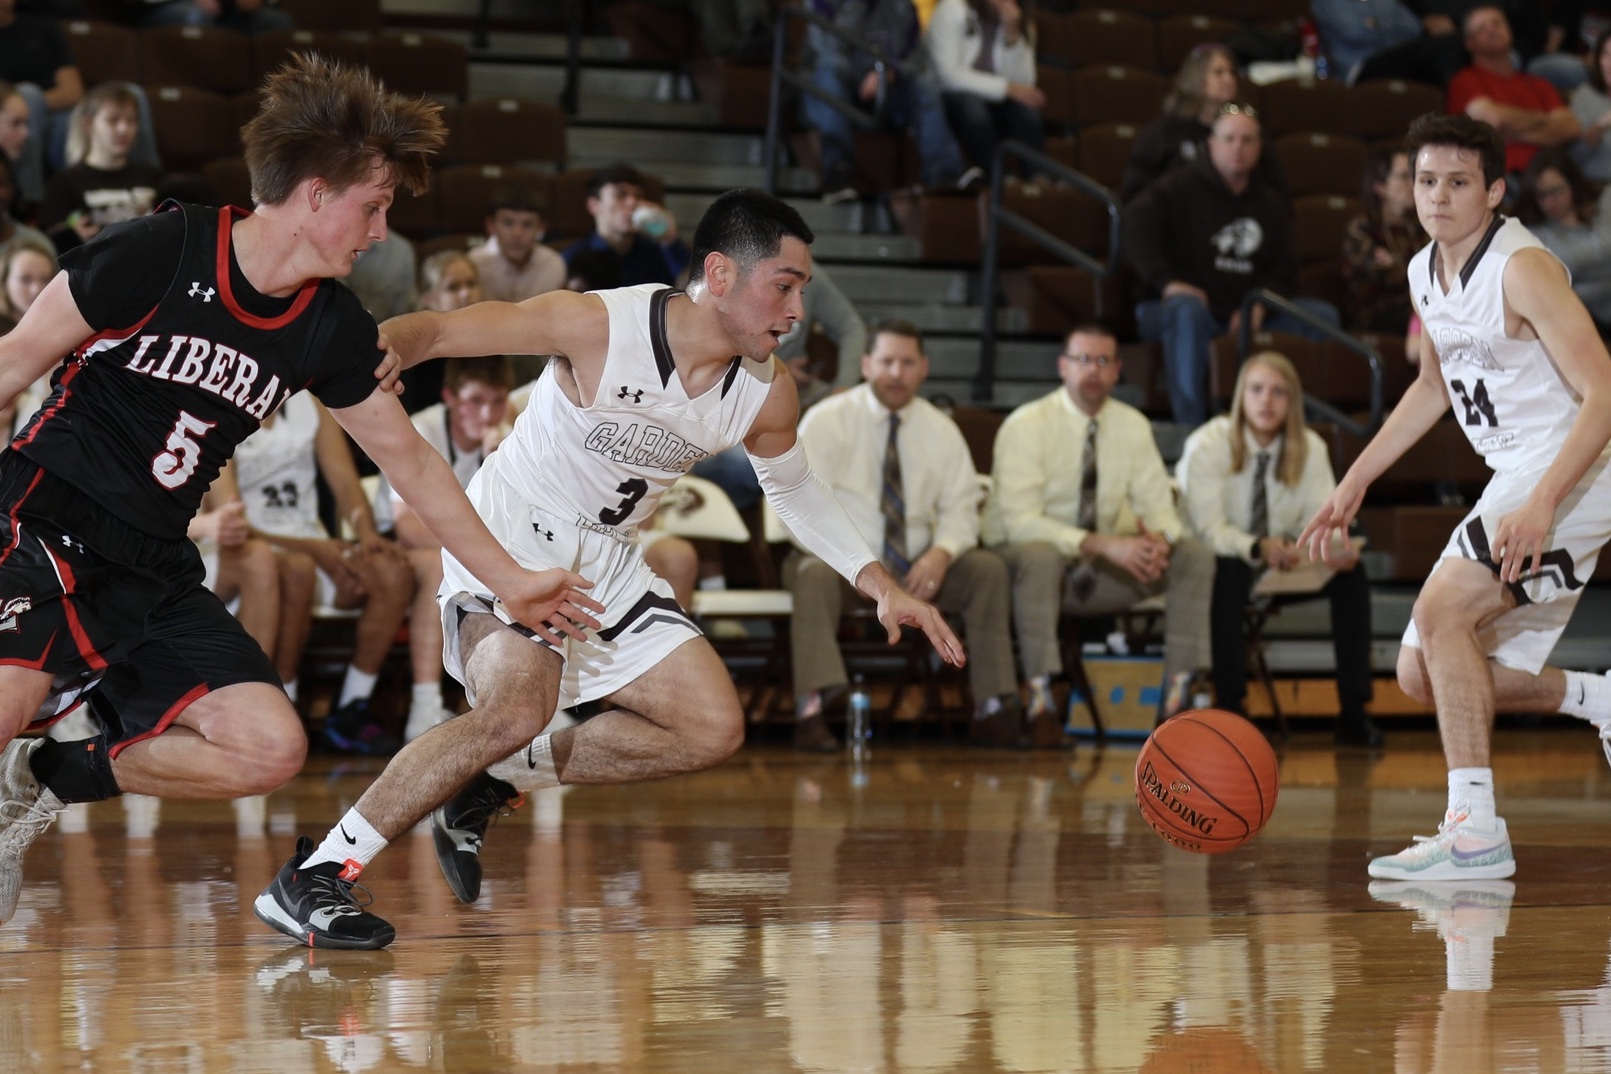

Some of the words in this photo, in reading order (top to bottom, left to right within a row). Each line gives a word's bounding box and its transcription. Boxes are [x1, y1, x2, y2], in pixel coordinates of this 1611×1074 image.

[1450, 378, 1499, 427] 24
[151, 409, 218, 492] 5
[598, 477, 648, 526] 3
[1140, 760, 1217, 834] SPALDING
